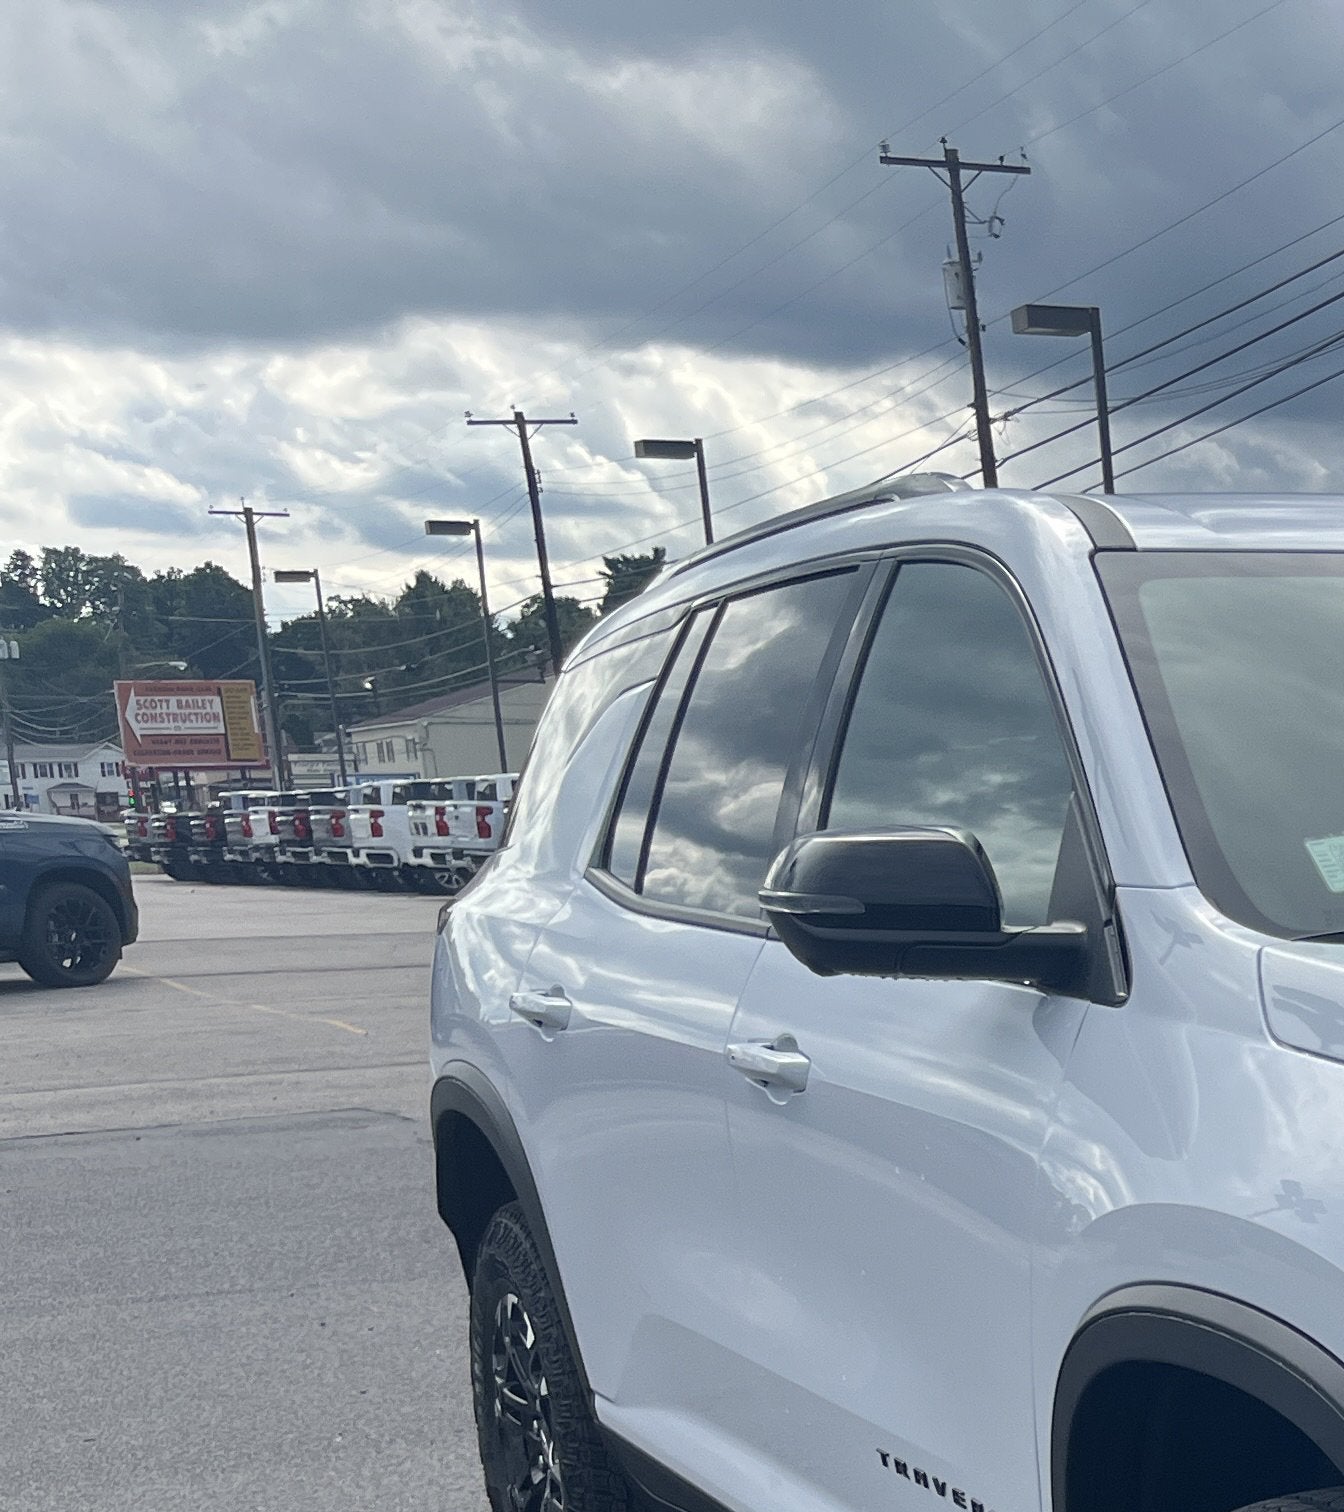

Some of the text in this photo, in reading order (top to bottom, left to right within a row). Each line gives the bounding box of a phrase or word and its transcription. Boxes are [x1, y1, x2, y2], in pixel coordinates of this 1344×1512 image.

[135, 698, 215, 711] SCOTT BAILEY
[134, 711, 221, 724] CONSTRUCTION
